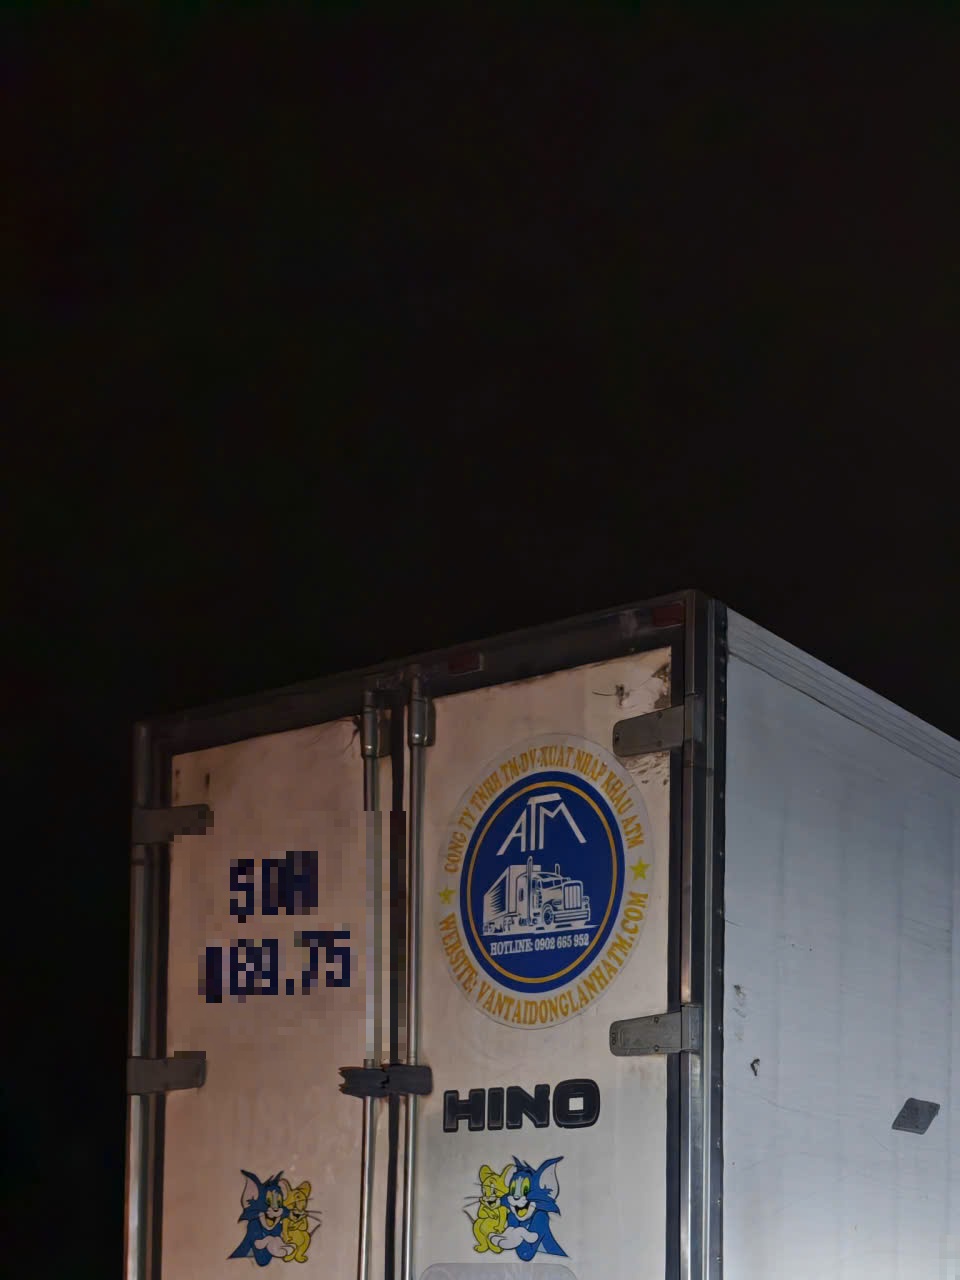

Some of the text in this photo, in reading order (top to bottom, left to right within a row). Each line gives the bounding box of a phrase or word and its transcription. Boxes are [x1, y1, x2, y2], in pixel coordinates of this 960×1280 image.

[496, 792, 587, 856] ATM
[534, 936, 556, 951] 0902
[573, 933, 590, 947] 952
[443, 1078, 600, 1132] HINO
